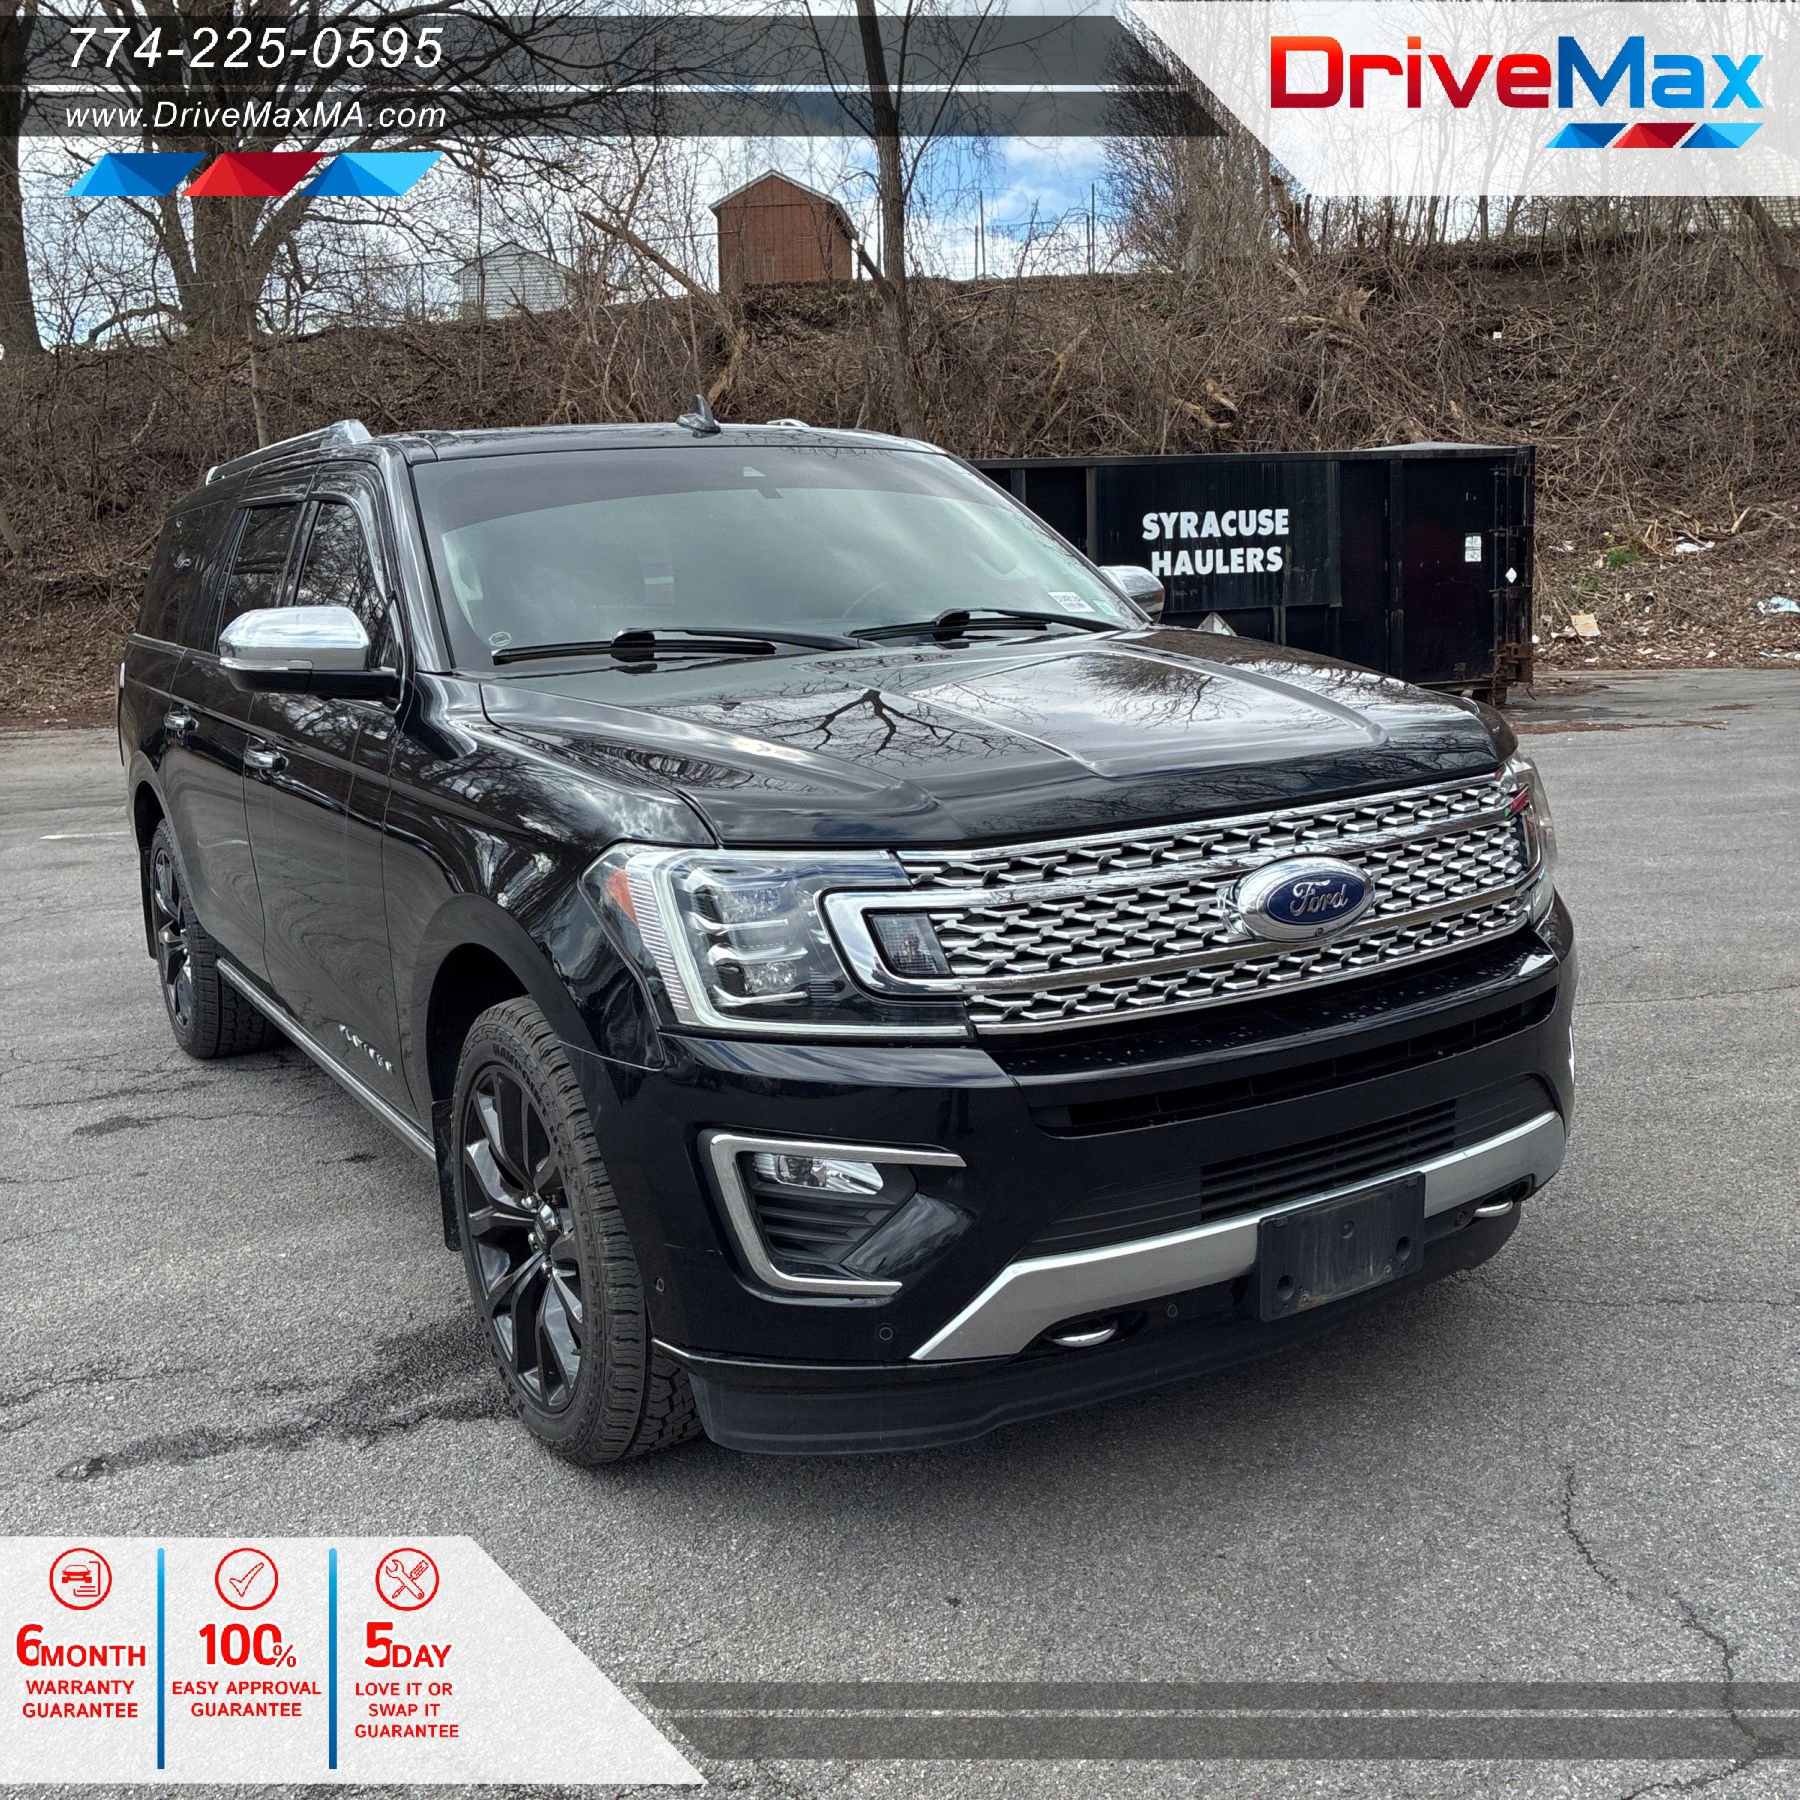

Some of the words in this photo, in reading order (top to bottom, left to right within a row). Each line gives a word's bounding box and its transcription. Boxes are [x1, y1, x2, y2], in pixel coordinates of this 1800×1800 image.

[1142, 508, 1289, 540] SYRACUSE
[1151, 546, 1283, 577] HAULERS
[1290, 879, 1348, 916] Ford
